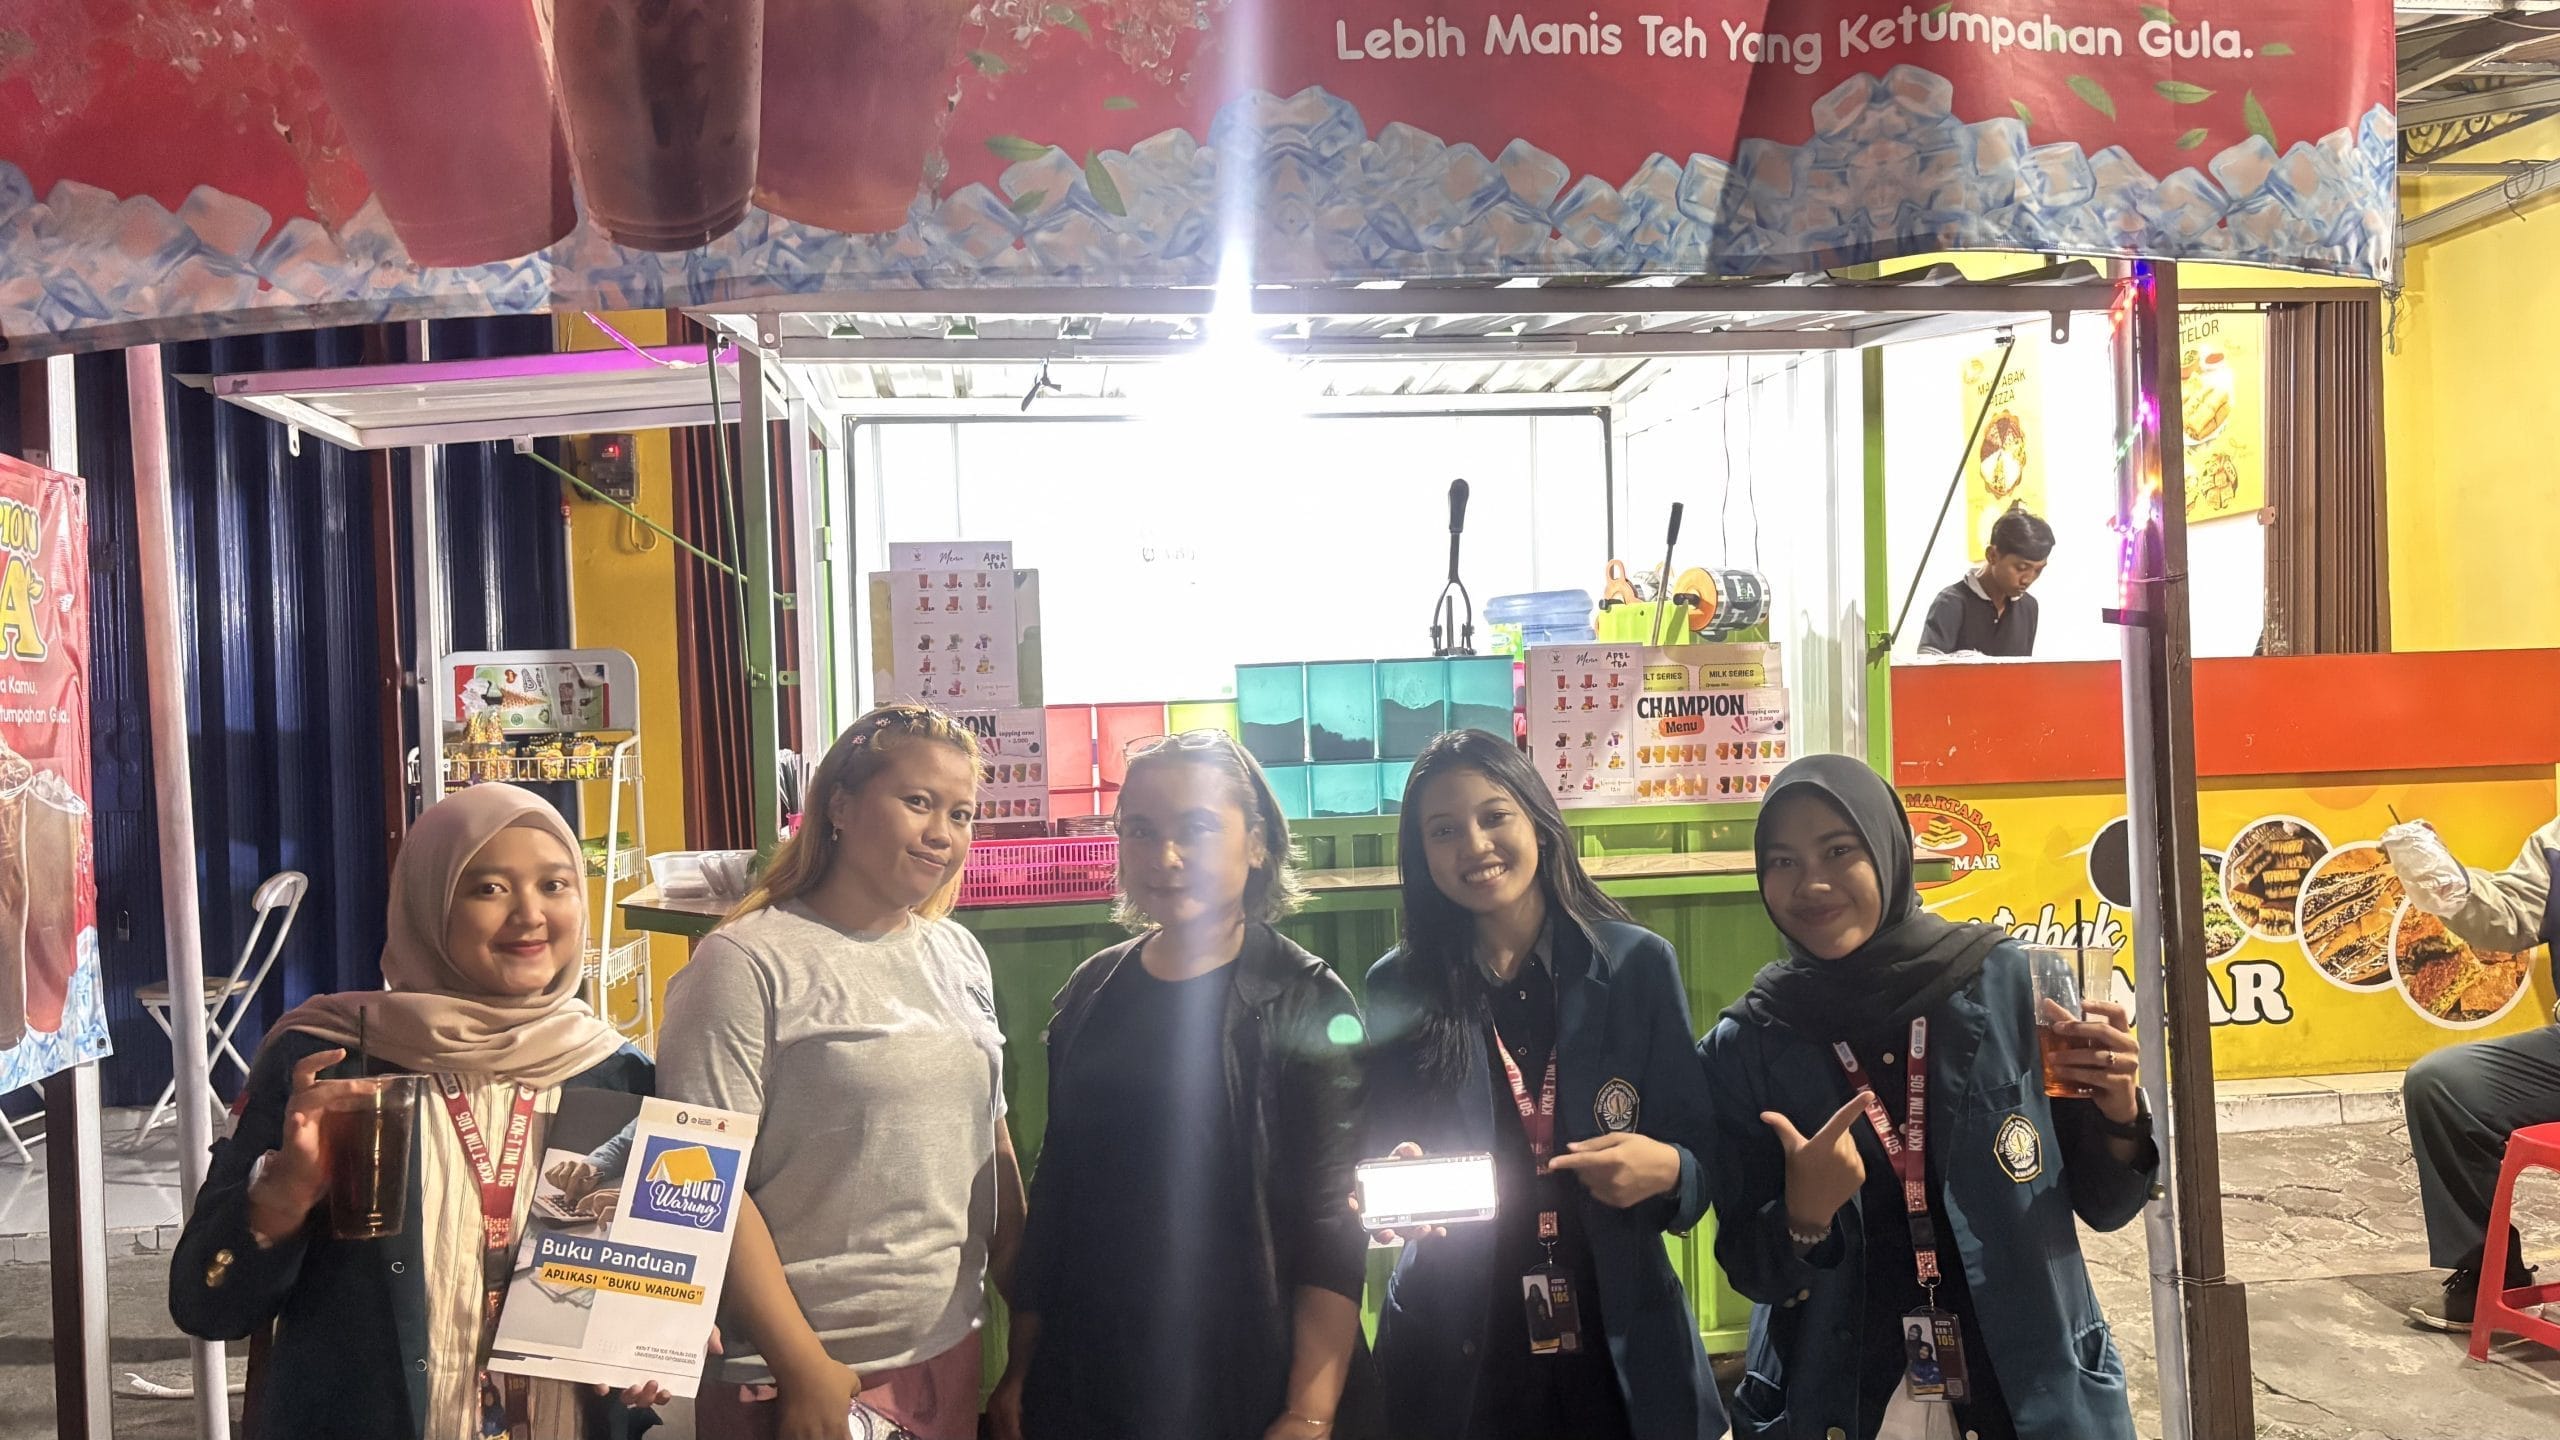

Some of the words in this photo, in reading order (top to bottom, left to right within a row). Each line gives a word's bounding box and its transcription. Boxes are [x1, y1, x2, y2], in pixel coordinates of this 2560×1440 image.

[1336, 15, 1466, 60] Lebih
[1484, 11, 1622, 56] Manis
[1638, 15, 1707, 59] Teh
[1721, 19, 1823, 75] Yang
[1839, 5, 2123, 58] Ketumpahan
[2138, 19, 2254, 59] Gula.
[2178, 319, 2219, 345] TELOR
[1606, 651, 1630, 660] APEL
[1611, 660, 1628, 668] TEA
[1656, 672, 1682, 680] SERIES
[1709, 670, 1727, 678] MILK
[1728, 669, 1754, 677] SERIES
[1637, 694, 1745, 719] CHAMPION
[1665, 719, 1698, 734] Menu
[1905, 794, 2001, 851] MARTABAK
[1544, 1064, 1556, 1081] TIM
[1910, 1074, 1925, 1093] 105
[1517, 1097, 1534, 1117] 105
[1541, 1083, 1555, 1115] KKN-T
[1909, 1096, 1924, 1116] TIM
[455, 1111, 475, 1132] 105
[507, 1113, 528, 1146] KKN-T
[463, 1131, 484, 1152] TIM
[1873, 1113, 1893, 1134] TIM
[1883, 1135, 1902, 1155] 105
[1909, 1117, 1923, 1151] KKN-T
[503, 1147, 521, 1165] TIM
[472, 1152, 496, 1184] KKN-T
[498, 1167, 516, 1188] 105
[681, 1178, 721, 1203] BUKU
[655, 1184, 717, 1223] Warung
[541, 1238, 593, 1261] Buku
[600, 1247, 687, 1276] Panduan
[544, 1268, 597, 1285] APLIKASI
[1936, 1335, 1954, 1346] 105
